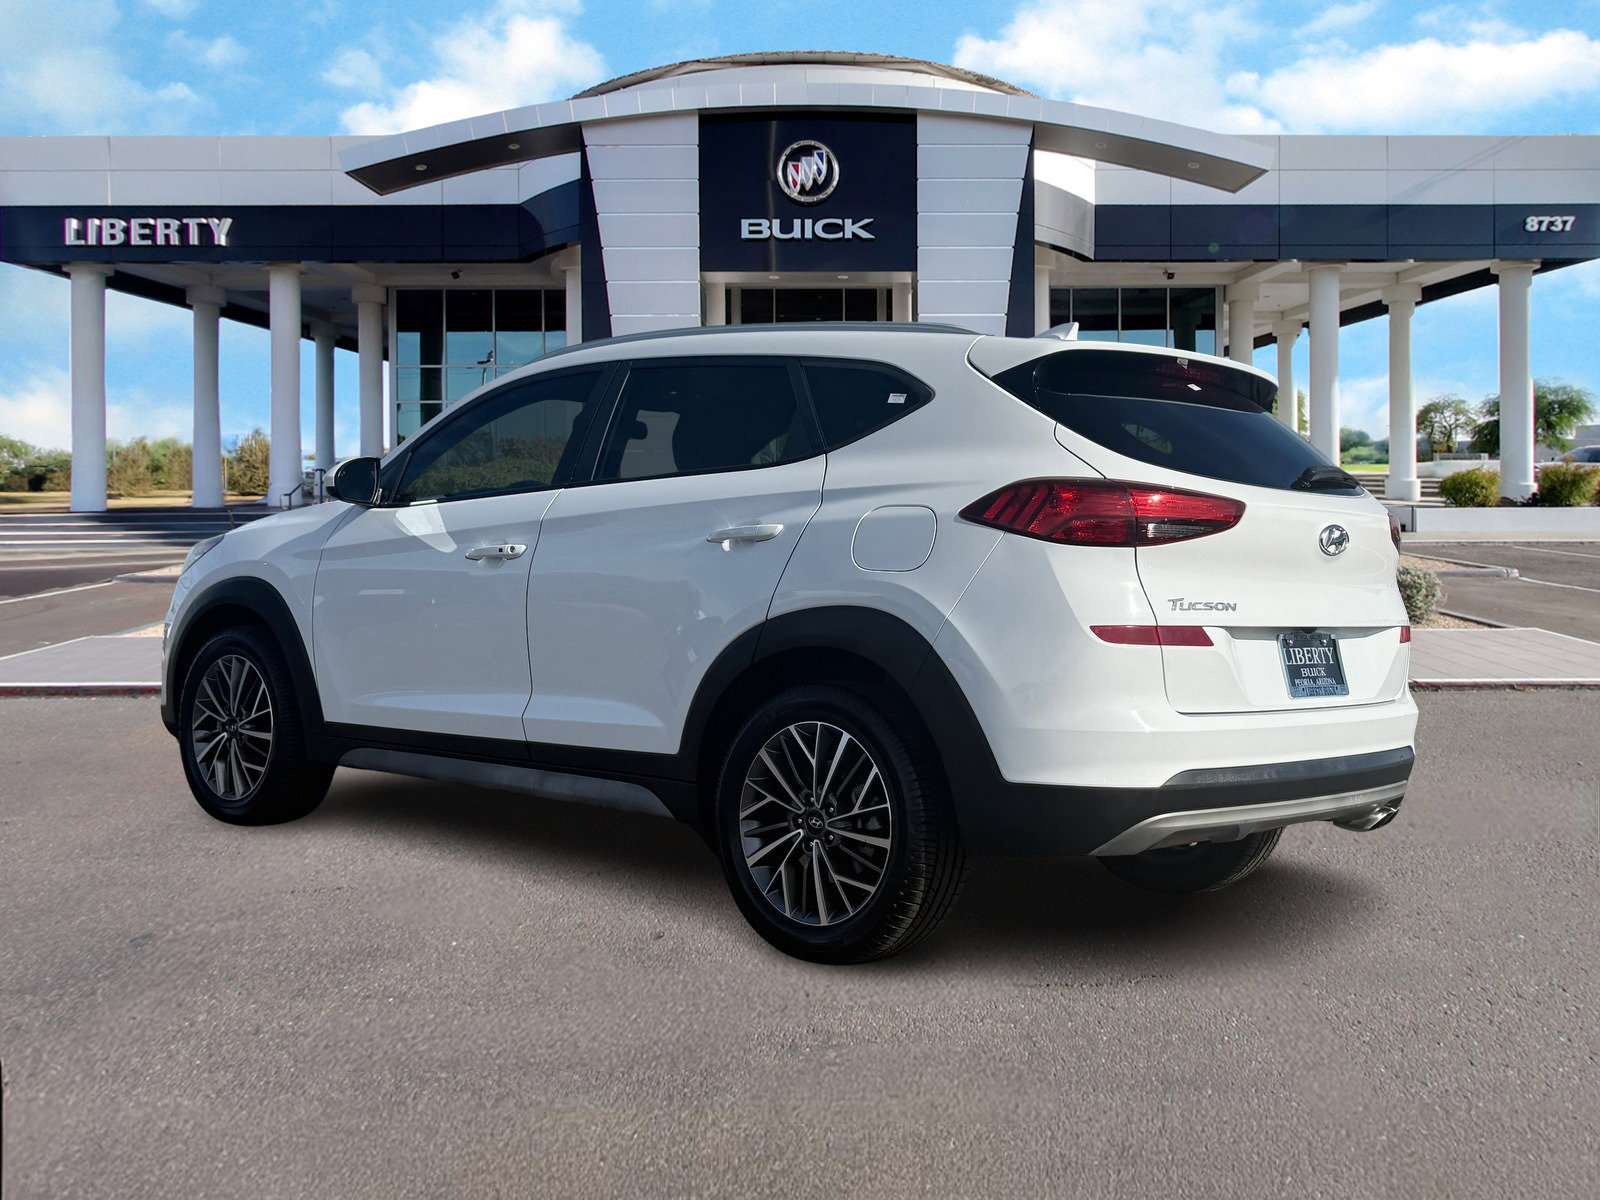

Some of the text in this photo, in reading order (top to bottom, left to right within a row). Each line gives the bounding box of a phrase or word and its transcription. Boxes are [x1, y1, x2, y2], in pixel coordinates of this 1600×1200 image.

[63, 217, 233, 247] LIBERTY
[740, 218, 876, 239] BUICK
[1524, 215, 1576, 232] 8737
[1283, 647, 1335, 665] LIBERTY
[1300, 667, 1327, 677] BUICK
